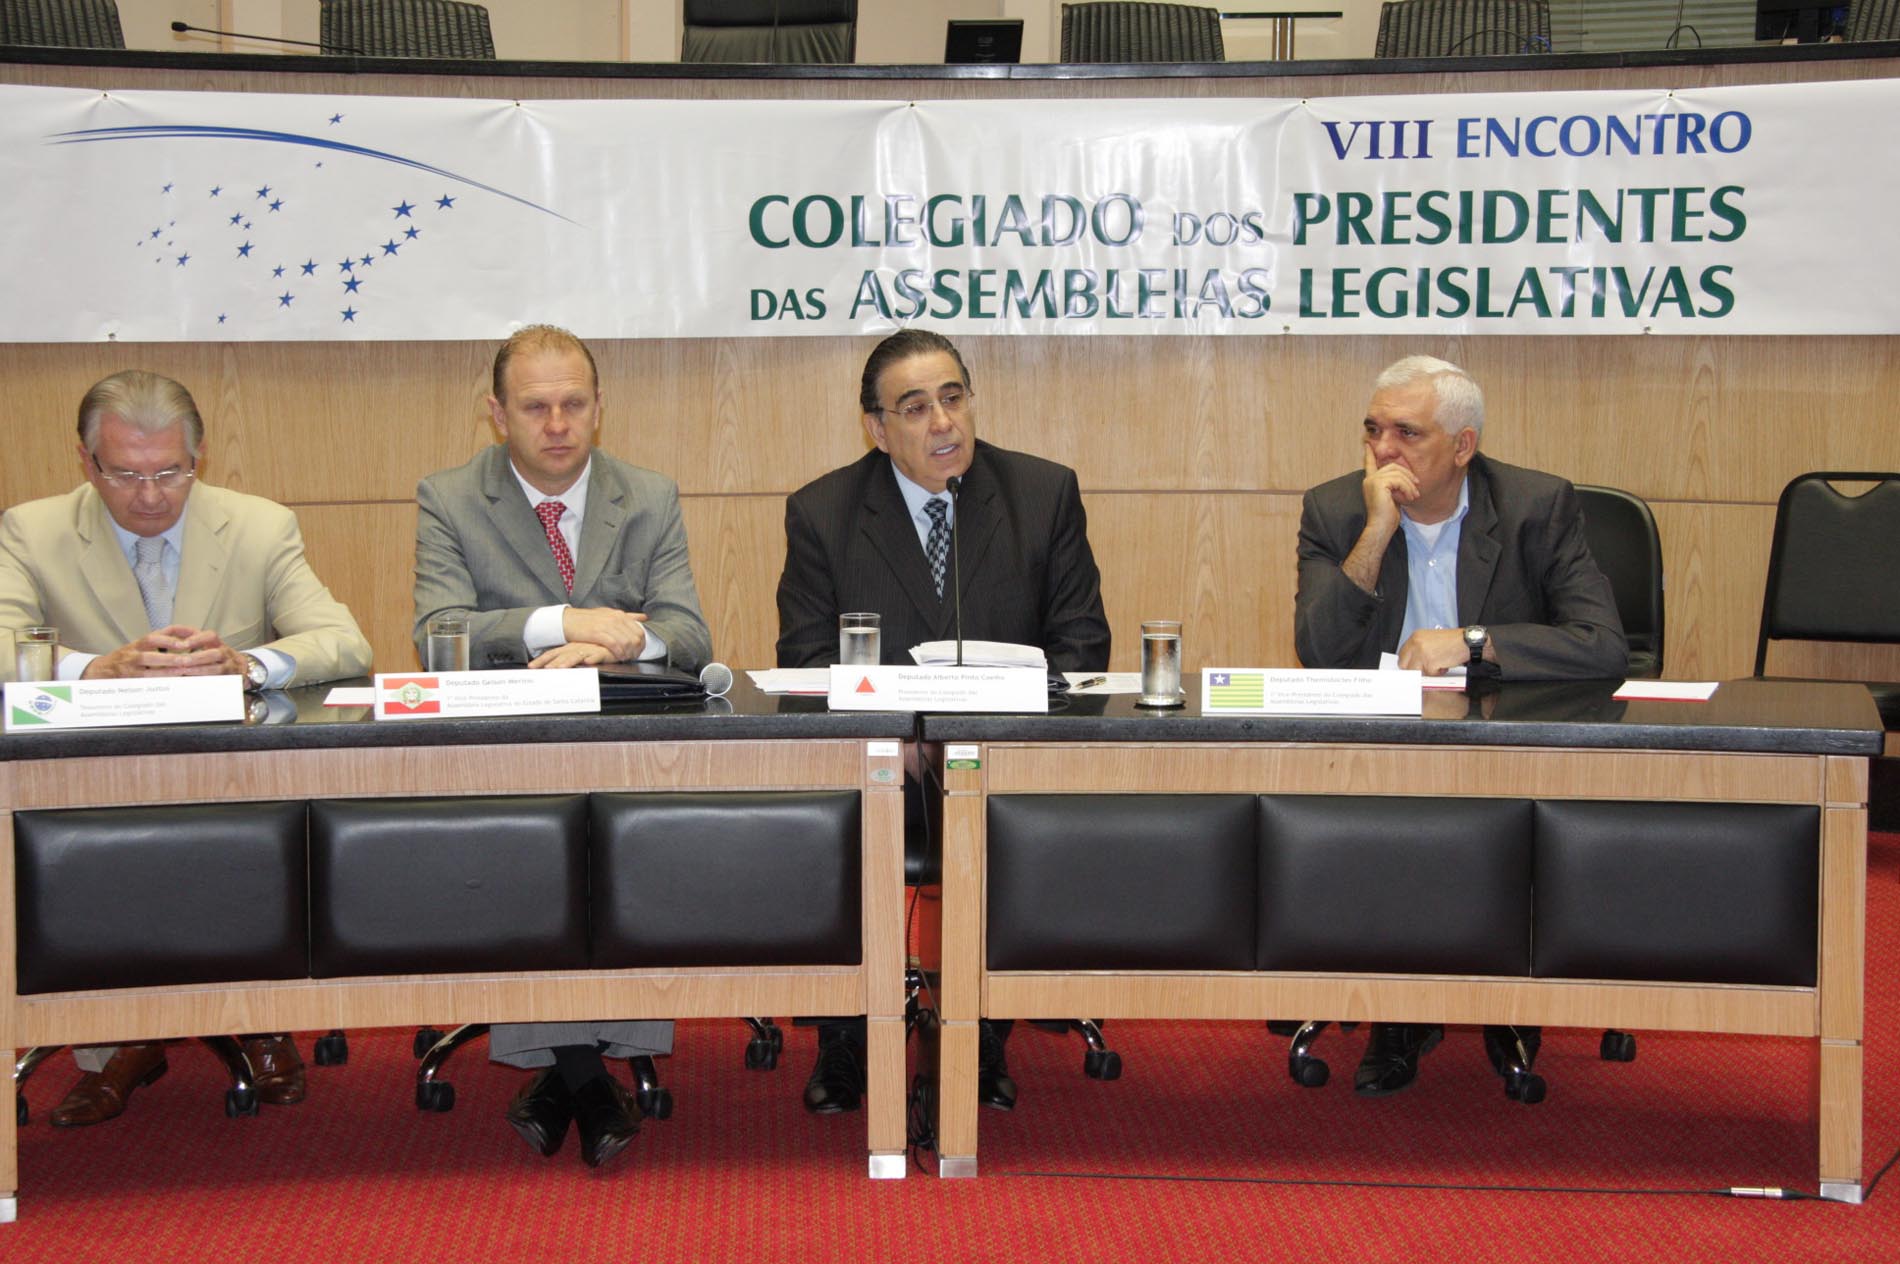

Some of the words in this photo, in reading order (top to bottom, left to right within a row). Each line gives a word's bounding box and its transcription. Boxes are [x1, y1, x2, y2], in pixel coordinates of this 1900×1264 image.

[1321, 119, 1434, 160] VIII
[1456, 110, 1753, 159] ENCONTRO
[748, 193, 1145, 248] COLEGIADO
[1173, 211, 1264, 247] DOS
[1292, 185, 1748, 246] PRESIDENTES
[750, 287, 828, 321] DAS
[849, 268, 1272, 320] ASSEMBLEIAS
[1299, 264, 1736, 319] LEGISLATIVAS
